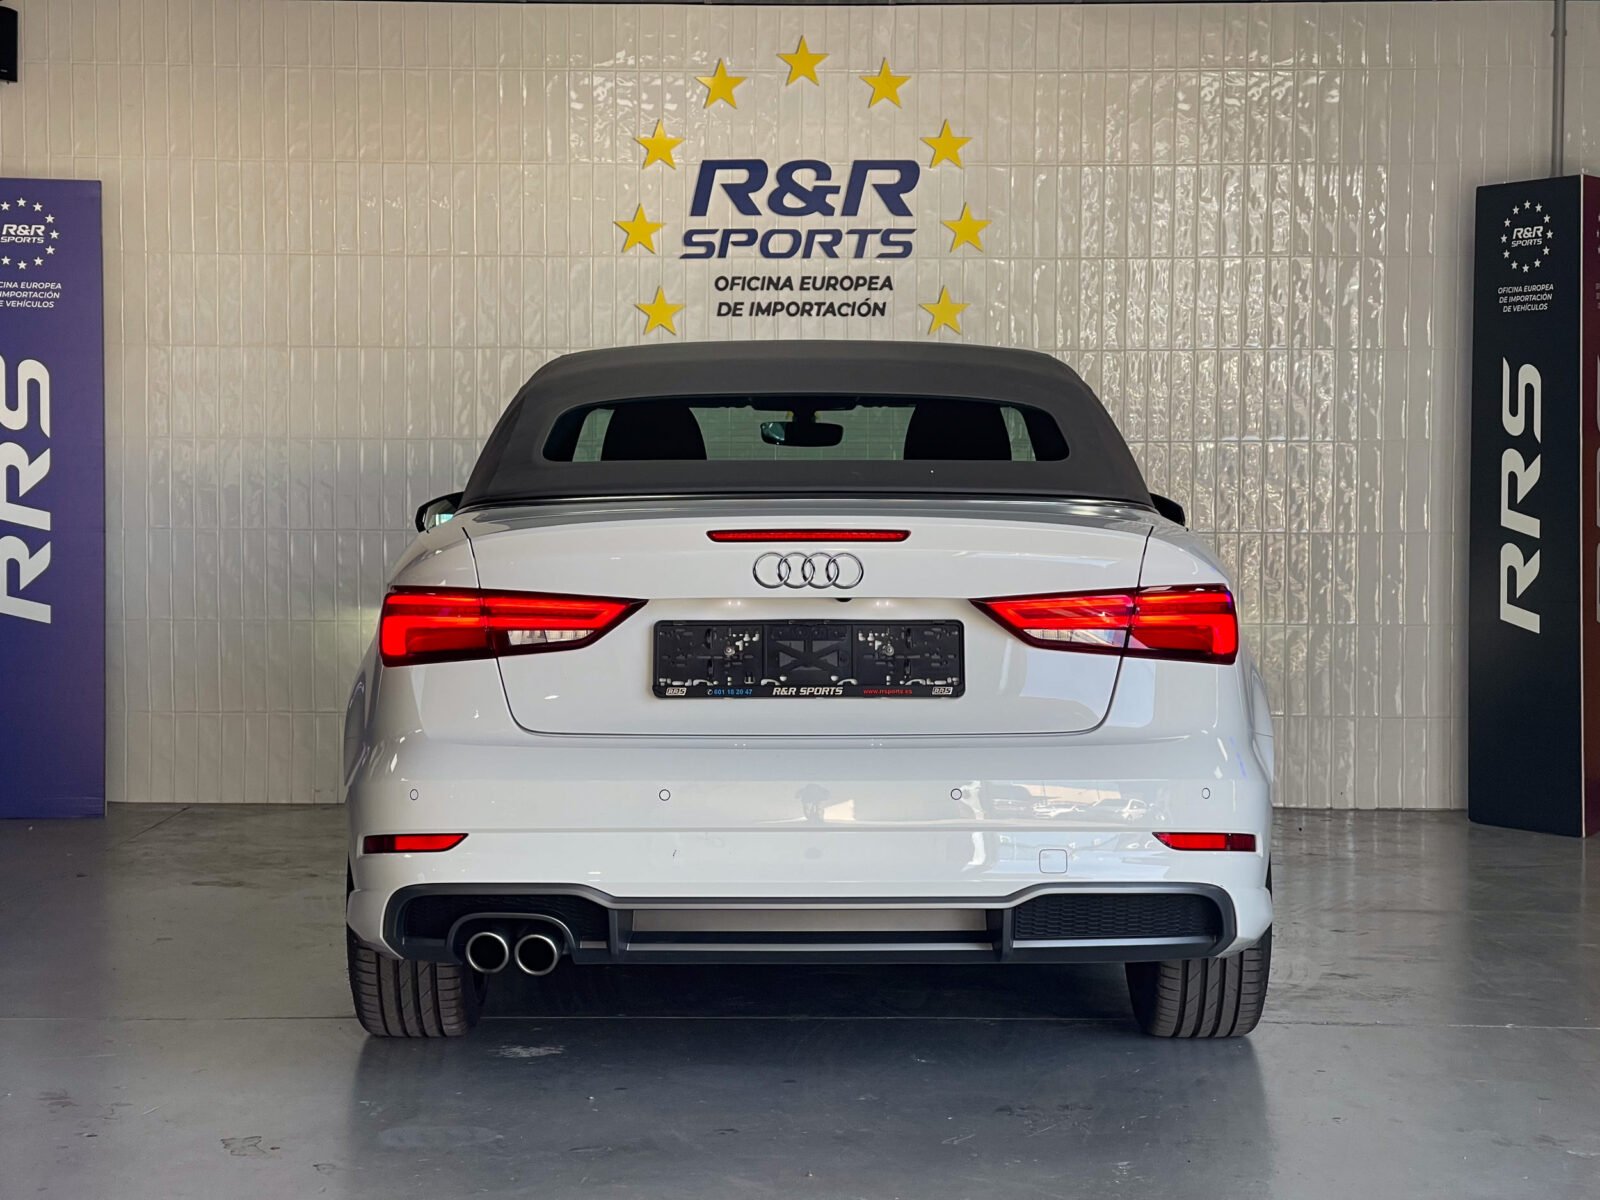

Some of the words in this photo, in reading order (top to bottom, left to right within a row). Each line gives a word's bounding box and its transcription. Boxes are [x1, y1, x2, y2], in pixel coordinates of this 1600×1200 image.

[689, 159, 920, 217] R&R
[2, 224, 45, 236] R&R
[1512, 226, 1543, 239] R&R
[680, 228, 917, 259] SPORTS
[1511, 238, 1542, 247] SPORTS
[714, 276, 794, 291] OFICINA
[799, 276, 893, 291] EUROPEA
[1497, 286, 1522, 294] OFICINA
[1523, 283, 1554, 292] EUROPEA
[1509, 292, 1552, 302] IMPORTACIÓN
[6, 299, 54, 308] VEHÍCULOS
[717, 302, 744, 317] DE
[749, 298, 886, 317] IMPORTACIÓN
[1513, 303, 1548, 311] VEHÍCULOS
[0, 356, 51, 624] RRS
[1500, 357, 1542, 634] RRS
[772, 687, 797, 696] R&R
[799, 687, 844, 696] SPORTS
